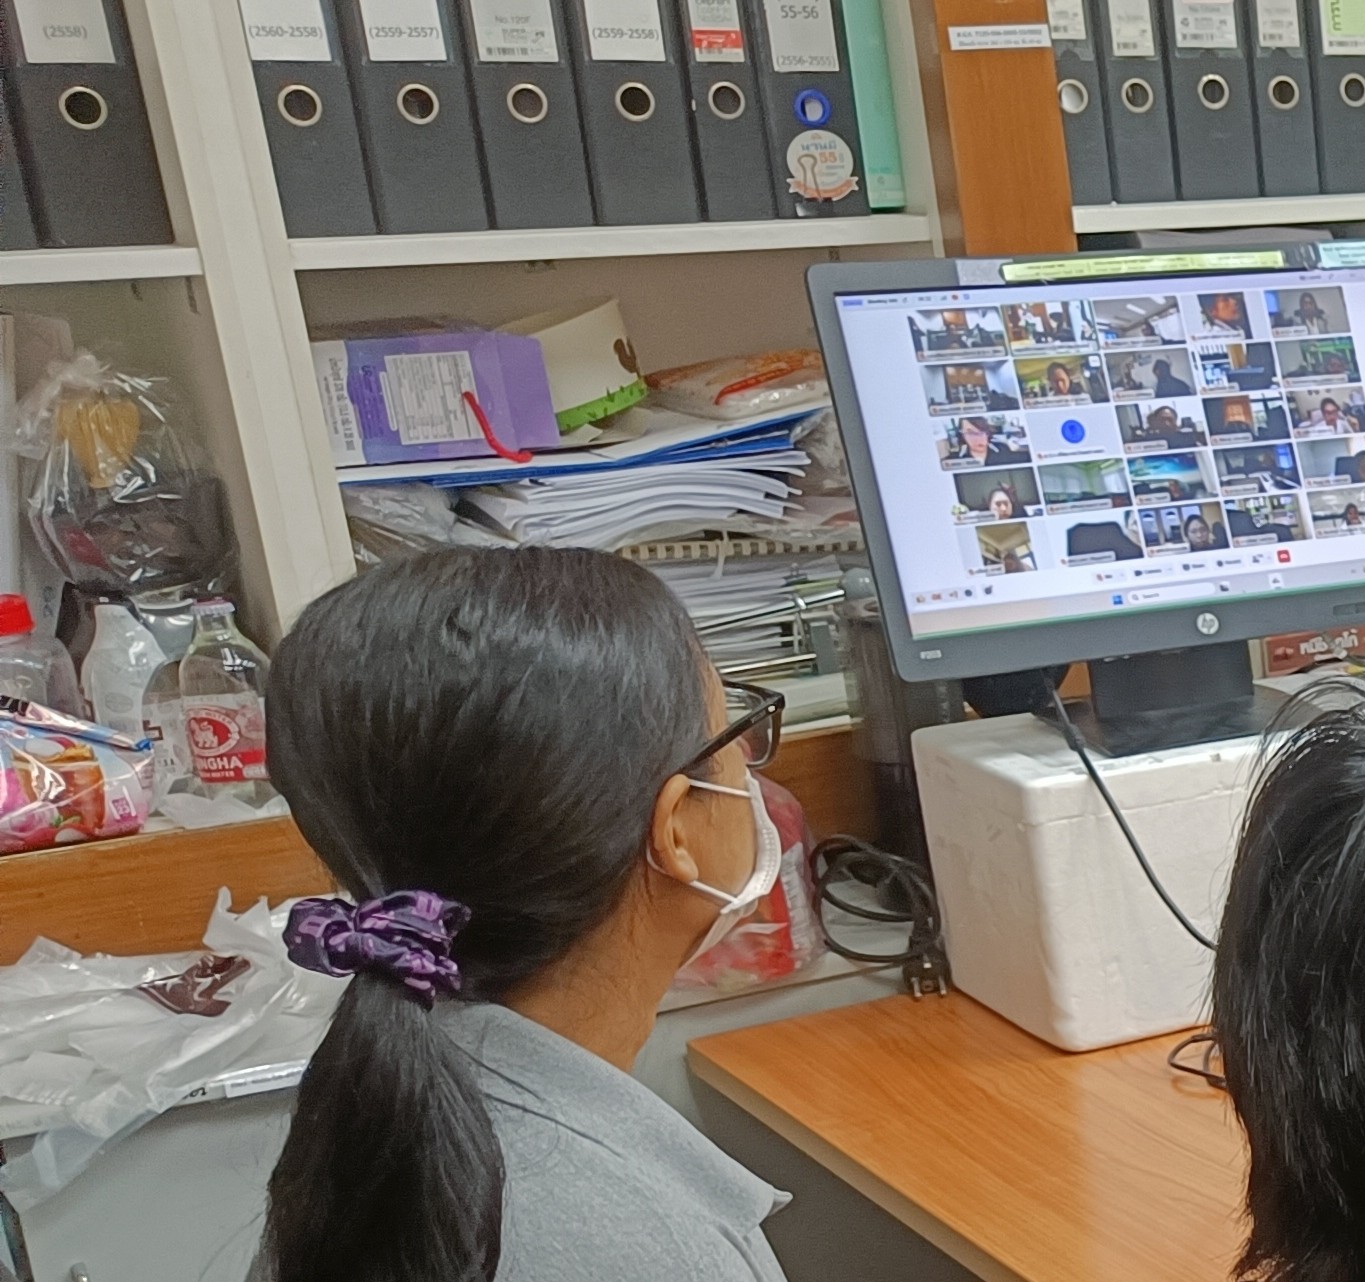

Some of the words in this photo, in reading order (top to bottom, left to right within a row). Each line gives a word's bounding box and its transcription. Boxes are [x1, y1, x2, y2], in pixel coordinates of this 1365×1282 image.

[780, 5, 819, 19] 55-56
[43, 25, 87, 39] (2558)
[249, 25, 323, 39] (2560-2558)
[369, 26, 440, 40] (2559-2557)
[592, 26, 659, 40] (2559-2558)
[819, 152, 837, 163] 55
